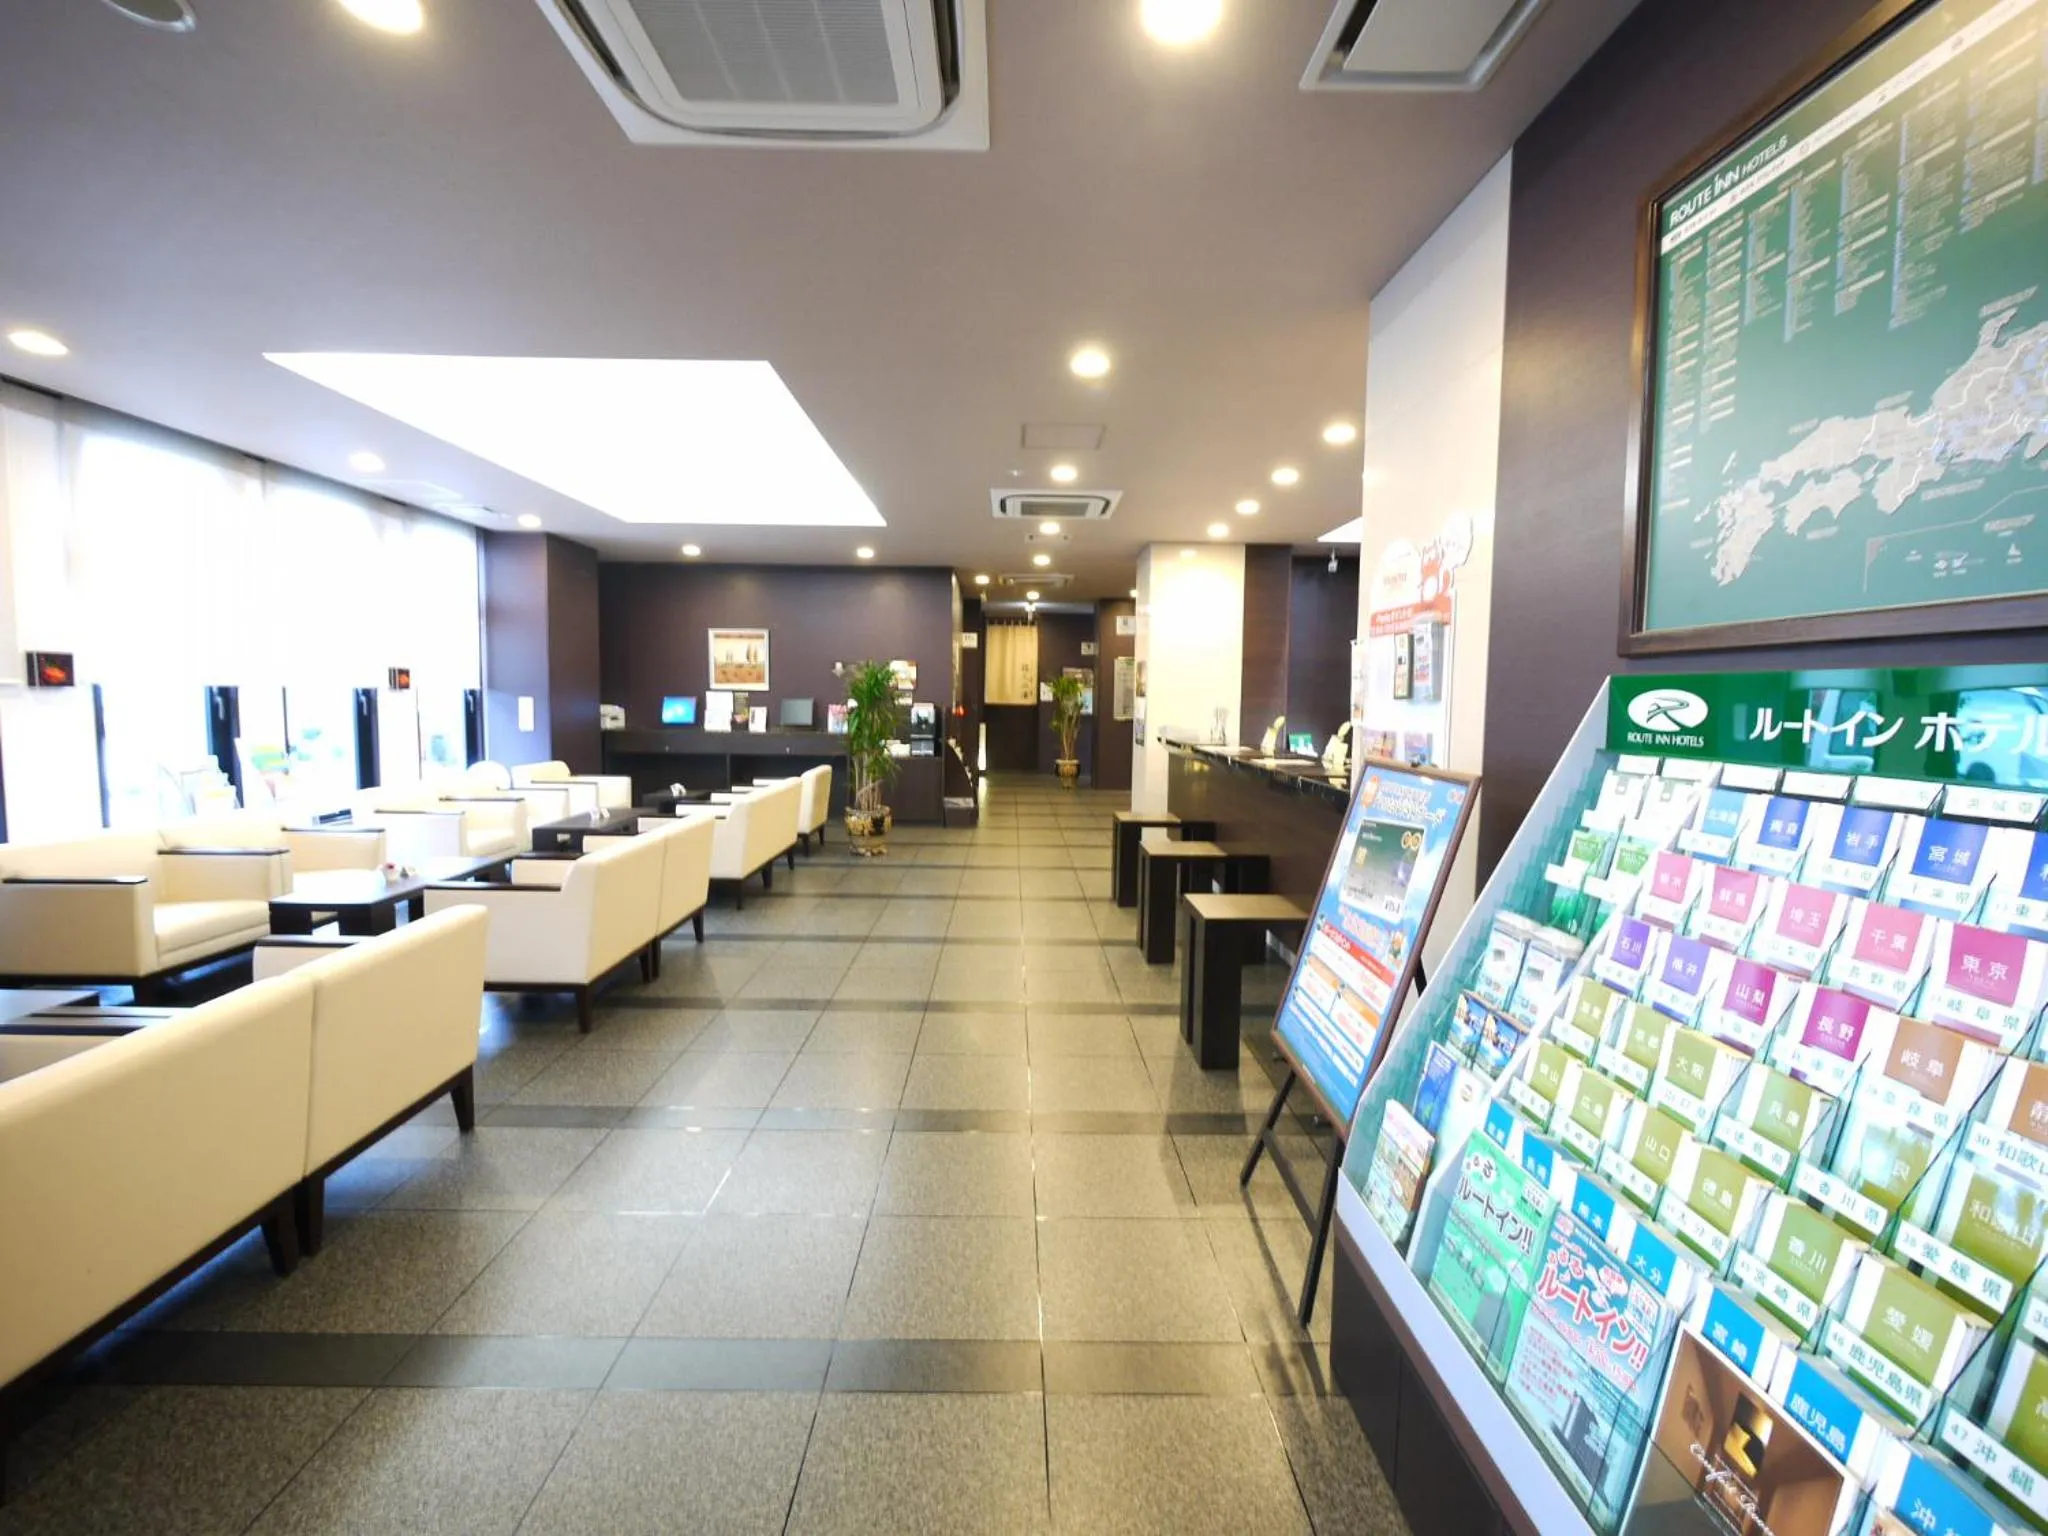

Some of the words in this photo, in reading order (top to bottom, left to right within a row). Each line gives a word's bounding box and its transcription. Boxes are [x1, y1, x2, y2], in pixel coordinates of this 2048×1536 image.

[1669, 185, 1713, 229] ROUTE
[1742, 134, 1788, 179] HOTELS
[1626, 731, 1653, 745] ROUTE
[1655, 733, 1672, 746] INN
[1672, 734, 1705, 748] HOTELS
[1750, 707, 1904, 748] ルートイン
[1788, 906, 1822, 928] 埼玉
[1620, 936, 1643, 954] 石川
[1870, 928, 1909, 952] 千葉
[1961, 954, 2010, 981] 東京
[1735, 983, 1766, 1006] 山梨
[1816, 1015, 1855, 1043] 長野
[1675, 1056, 1704, 1080] 大阪
[1900, 1049, 1944, 1077] 岐阜
[1645, 1134, 1671, 1161] 山口
[1817, 1180, 1880, 1224] 香川県
[1633, 1253, 1663, 1286] 大分
[1787, 1234, 1827, 1275] 香川
[1921, 1243, 2004, 1301] 愛媛県
[1537, 1265, 1649, 1371] ルートイン!!
[1882, 1305, 1935, 1353] 愛媛
[1847, 1342, 1924, 1410] 鹿児島県
[1790, 1391, 1848, 1455] 鹿児島
[1973, 1438, 2036, 1498] 沖縄
